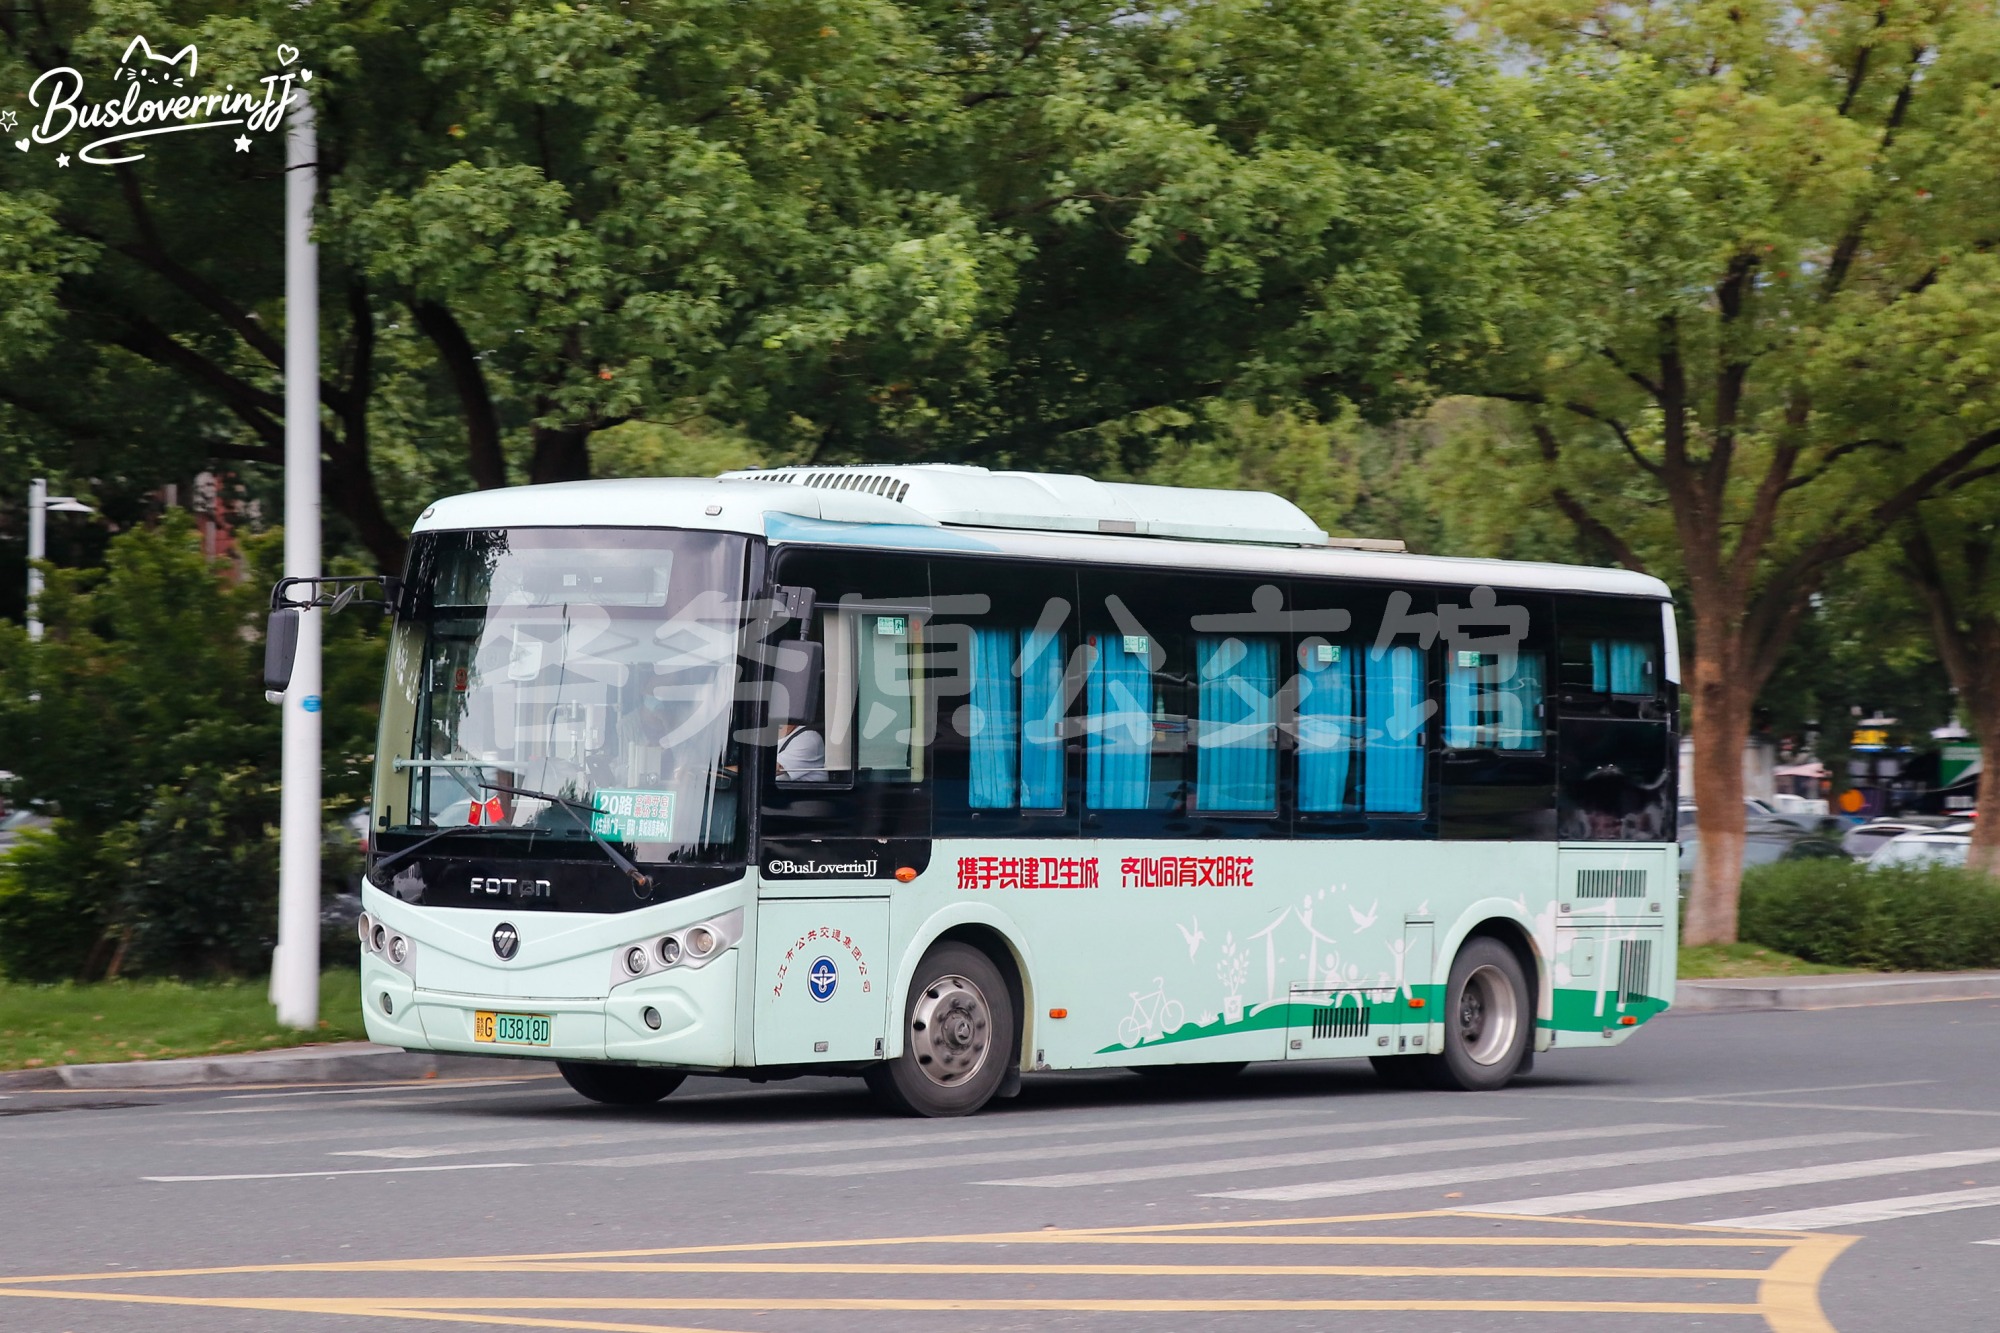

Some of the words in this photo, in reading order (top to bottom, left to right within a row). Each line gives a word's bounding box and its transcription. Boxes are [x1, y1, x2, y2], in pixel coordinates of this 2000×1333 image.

[957, 856, 1099, 890] 携手共建卫生城
[1120, 856, 1254, 888] 齐心同育文明花
[773, 926, 871, 997] 九江市公共交通集团公司
